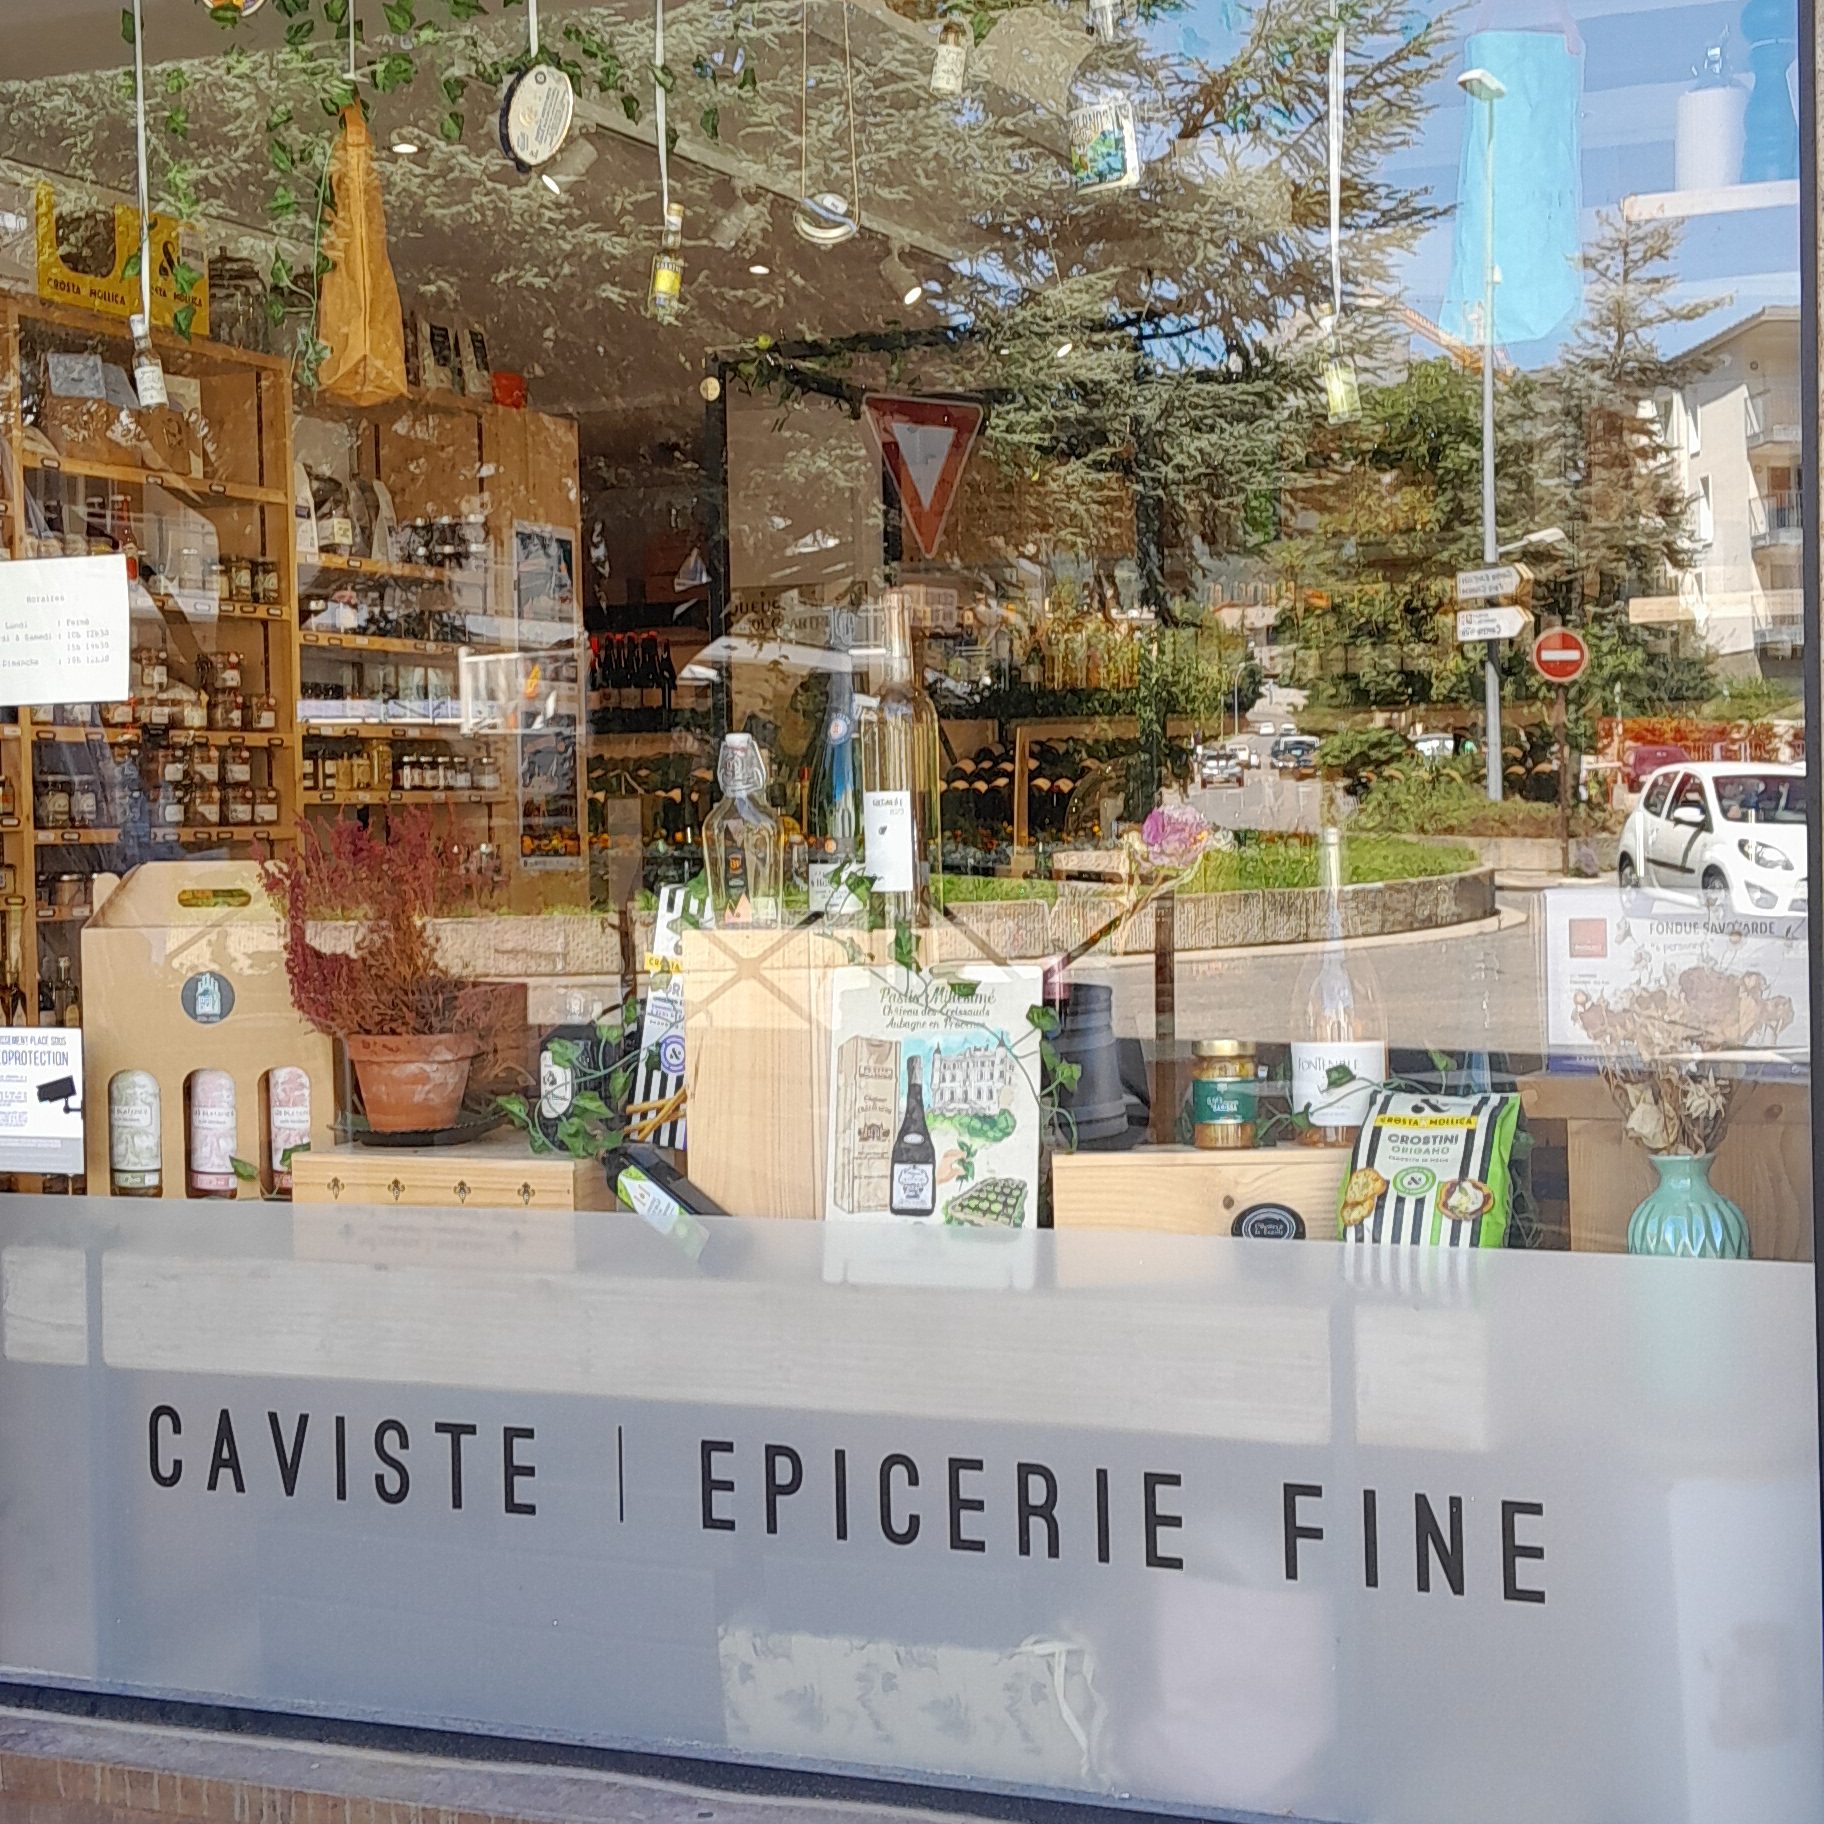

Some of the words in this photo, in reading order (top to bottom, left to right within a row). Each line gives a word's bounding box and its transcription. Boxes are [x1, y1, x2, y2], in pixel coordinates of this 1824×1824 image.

[47, 278, 81, 295] CROSTA
[90, 288, 126, 306] MOLLICA
[1649, 920, 1699, 935] FONDUE
[649, 957, 681, 972] CRTA
[1379, 1115, 1419, 1127] CROSTA
[1429, 1117, 1473, 1127] MOLLICA
[1387, 1133, 1460, 1146] CROSTINI
[148, 1404, 537, 1516] CAVISTE
[700, 1438, 1184, 1570] EPICERIE
[1283, 1482, 1546, 1604] FINE
